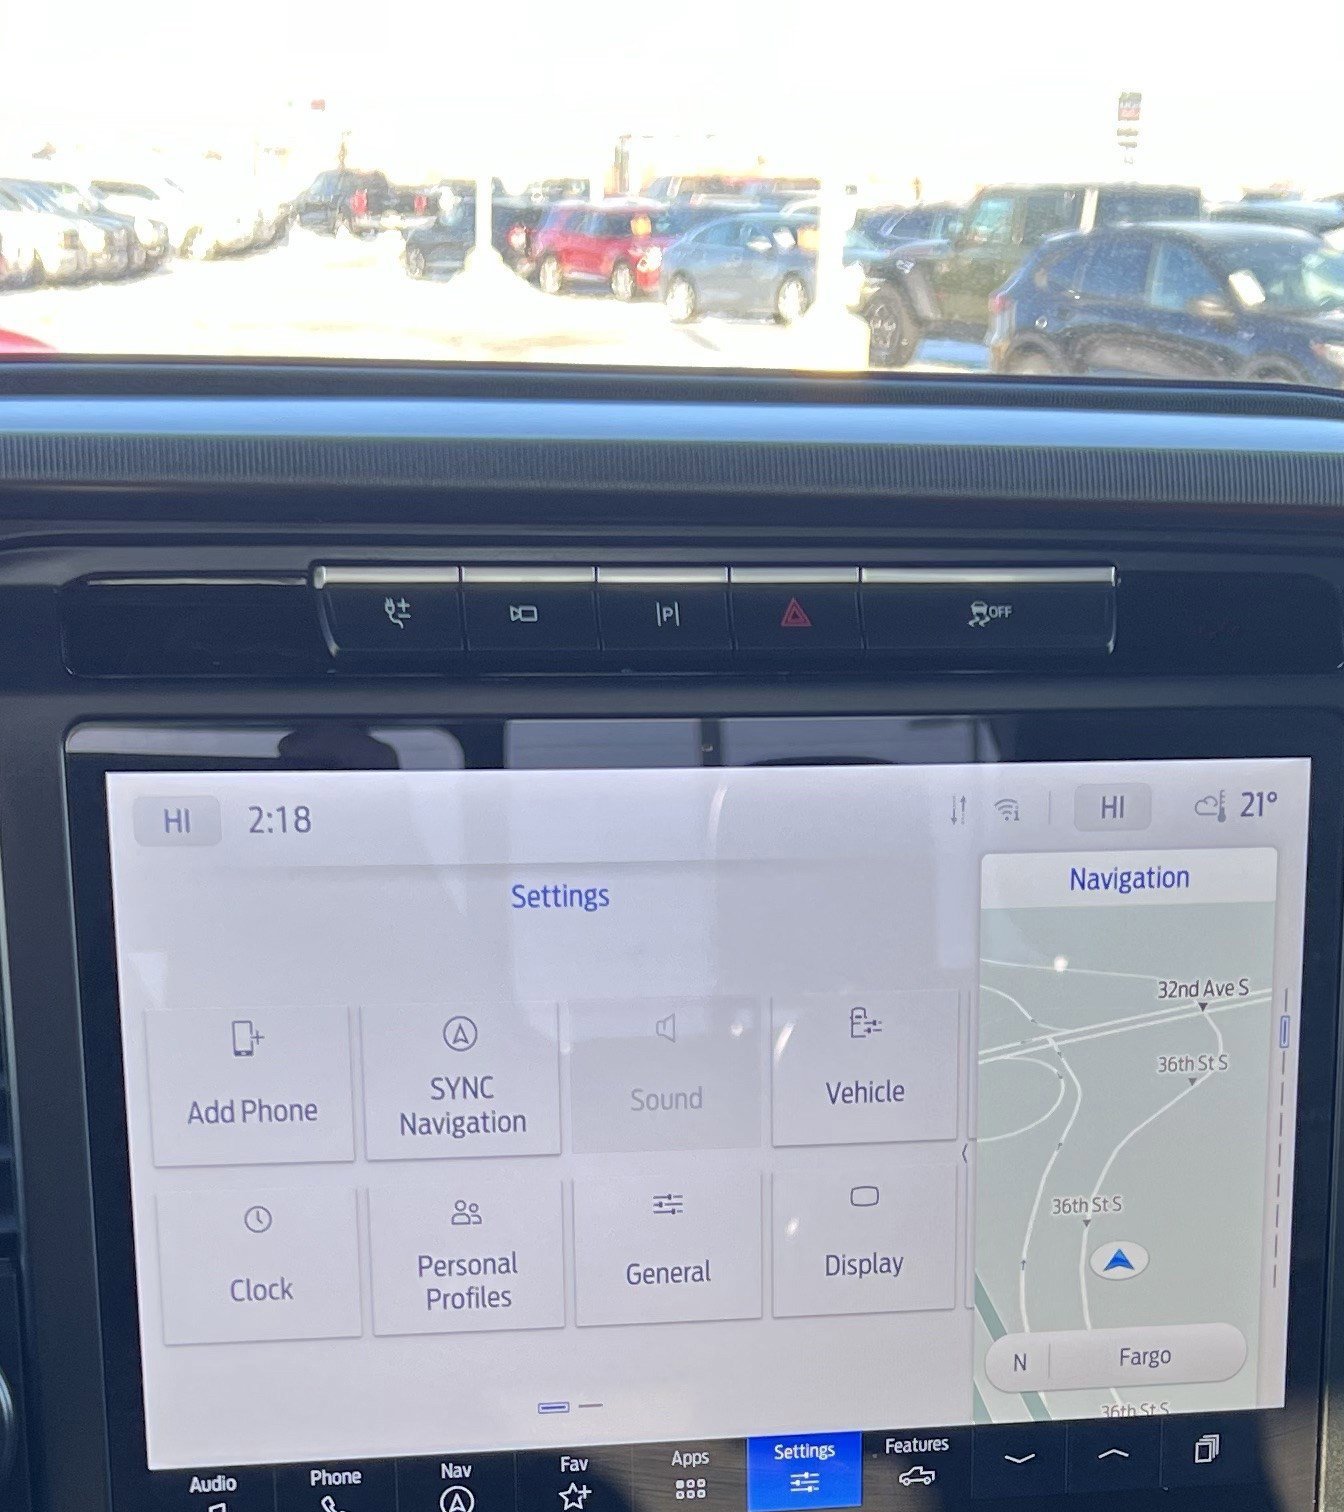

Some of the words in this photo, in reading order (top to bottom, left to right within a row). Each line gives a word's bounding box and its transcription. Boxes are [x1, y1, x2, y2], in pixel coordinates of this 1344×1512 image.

[988, 604, 1012, 619] OFF
[1240, 791, 1278, 818] 21°
[248, 805, 312, 834] 2:18
[1069, 866, 1190, 893] Navigation
[511, 884, 610, 911] Settings
[1158, 979, 1199, 998] 32nd
[1204, 978, 1233, 997] Ave
[1238, 977, 1249, 996] S
[1158, 1055, 1193, 1073] 36th
[1197, 1055, 1214, 1072] St
[1217, 1054, 1228, 1071] S
[430, 1076, 495, 1101] SYNC
[630, 1085, 703, 1112] Sound
[826, 1078, 906, 1104] Vehicle
[187, 1100, 236, 1125] Add
[241, 1098, 319, 1123] Phone
[399, 1109, 527, 1139] Navigation
[1052, 1197, 1088, 1216] 36th
[1092, 1196, 1109, 1214] St
[1113, 1196, 1123, 1213] S
[417, 1250, 518, 1278] Personal
[626, 1259, 712, 1286] General
[824, 1251, 905, 1280] Display
[229, 1277, 294, 1302] Clock
[426, 1283, 512, 1312] Profiles
[1013, 1353, 1027, 1373] N
[1119, 1347, 1172, 1368] Fargo
[774, 1443, 836, 1463] Settings
[885, 1436, 950, 1455] Features
[440, 1463, 472, 1482] Nav
[560, 1455, 589, 1475] Fav
[671, 1449, 710, 1472] Apps
[189, 1474, 237, 1495] Audio
[309, 1468, 362, 1489] Phone
